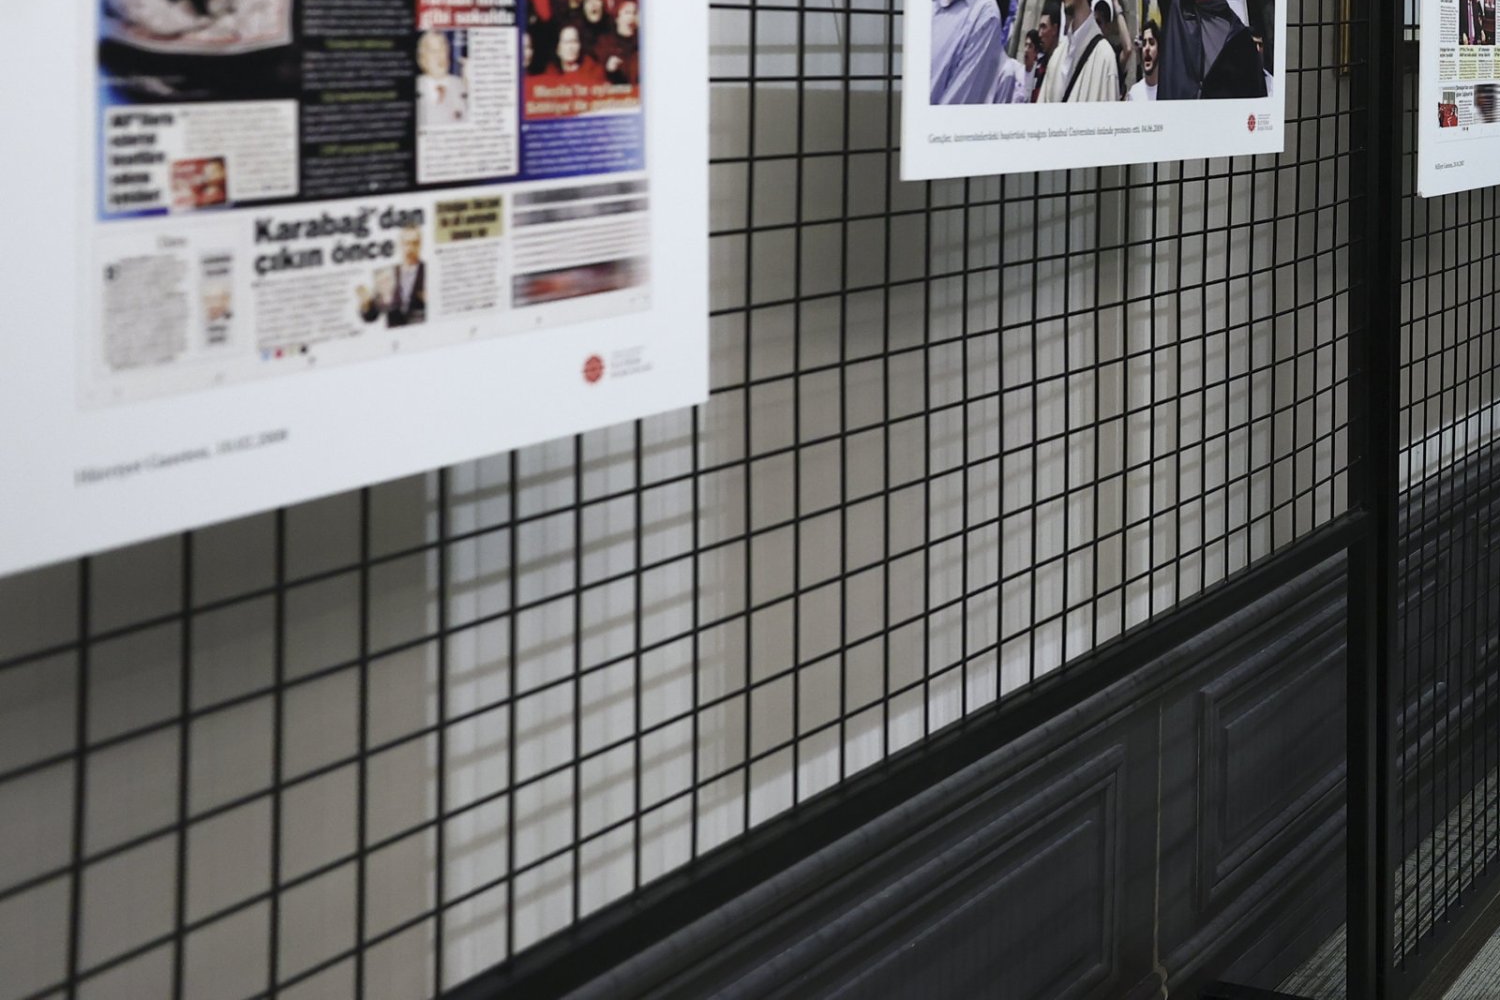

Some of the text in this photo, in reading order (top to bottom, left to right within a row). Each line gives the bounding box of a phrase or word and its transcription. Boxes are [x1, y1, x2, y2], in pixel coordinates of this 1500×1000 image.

[254, 206, 425, 245] Karabağ'dan
[254, 239, 395, 276] çıkın önce
